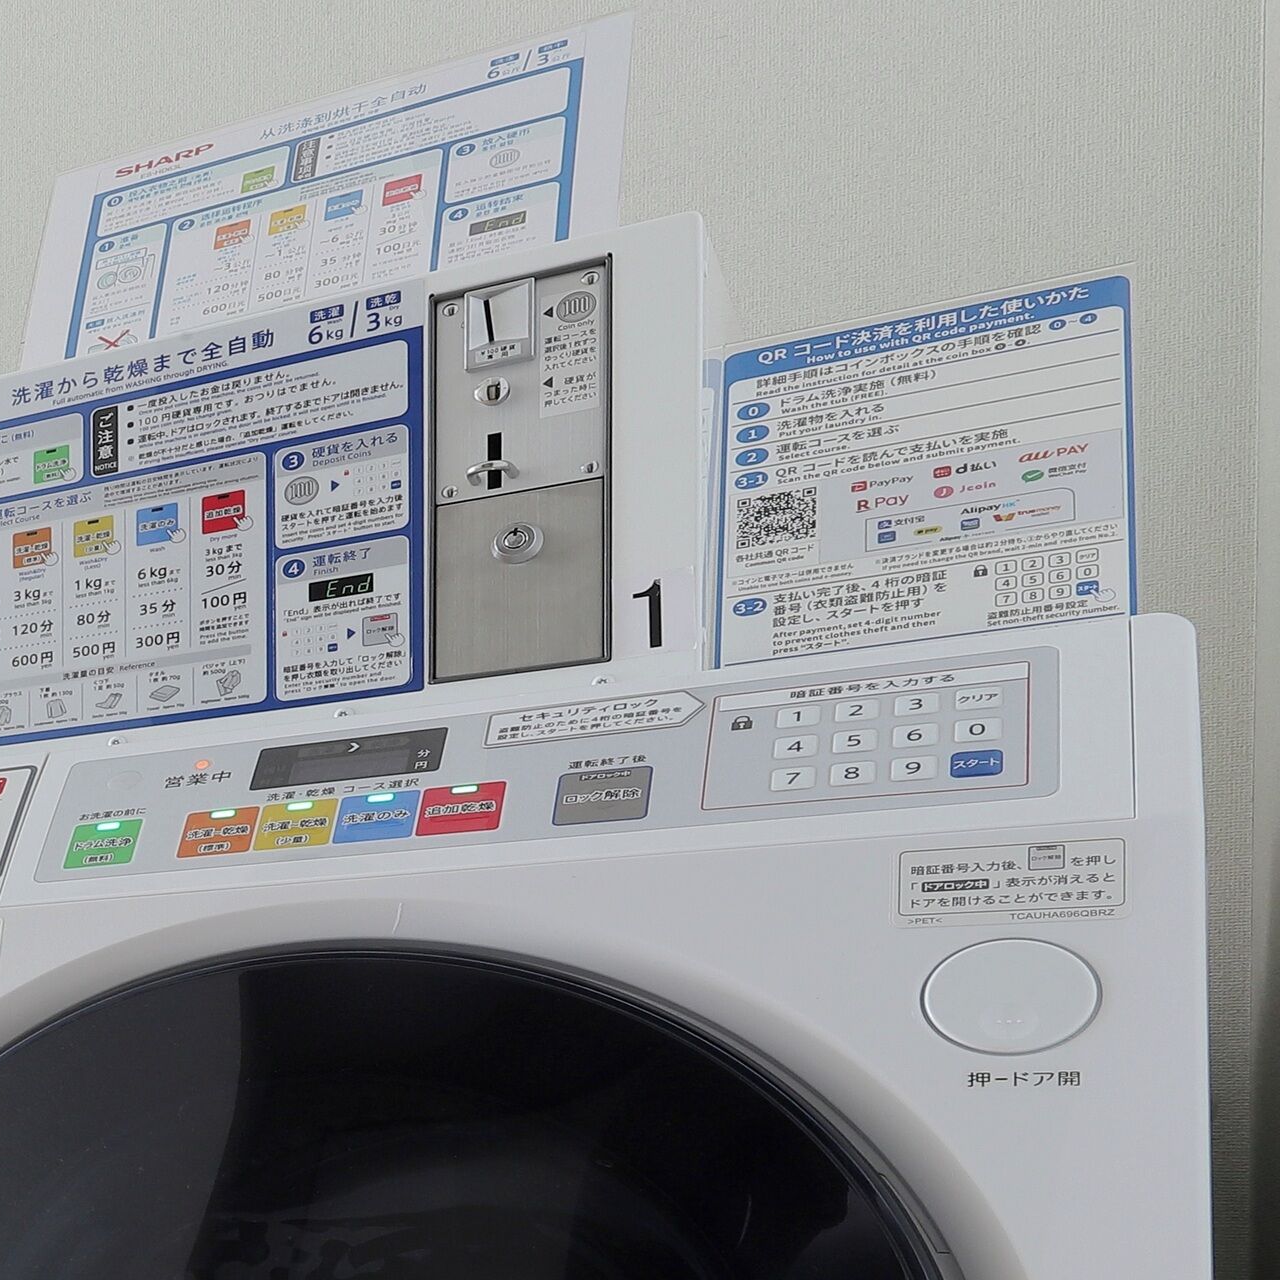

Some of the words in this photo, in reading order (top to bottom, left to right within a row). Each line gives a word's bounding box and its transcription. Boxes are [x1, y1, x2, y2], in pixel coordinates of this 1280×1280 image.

[115, 142, 214, 179] SHARP
[557, 321, 572, 332] Coin
[573, 318, 595, 330] only
[806, 353, 834, 364] How
[854, 344, 877, 356] use
[879, 337, 909, 352] with
[911, 333, 932, 347] QR
[934, 328, 967, 342] code
[969, 313, 1034, 335] payment.
[11, 328, 275, 407] 洗濯から乾燥まで全自動
[777, 402, 885, 432] 洗濯物を入れる
[96, 412, 114, 460] ご注意
[776, 425, 900, 455] 運転コースを選ぶ
[312, 433, 398, 459] 硬貨を入れる
[312, 455, 344, 467] Deposit
[345, 449, 372, 462] Coins
[94, 461, 117, 474] NOTICE
[869, 473, 914, 488] PayPay
[13, 514, 40, 524] Course
[312, 547, 371, 568] 運転終了
[313, 566, 339, 576] Finish
[326, 575, 372, 597] End
[633, 578, 662, 648] 1
[772, 598, 923, 628] 設定し、スタートを押す
[1044, 608, 1079, 622] security
[1080, 603, 1120, 617] number.
[119, 661, 155, 672] Reference
[789, 673, 956, 700] 暗証番号を入力する
[909, 697, 923, 710] 3
[957, 692, 1000, 705] クリア
[519, 697, 659, 723] セキュリティロック
[848, 704, 864, 717] 2
[907, 727, 922, 743] 6
[968, 722, 985, 736] 0
[786, 740, 804, 754] 4
[847, 734, 861, 747] 5
[568, 753, 647, 770] 運転終了後
[905, 761, 922, 776] 9
[952, 755, 1001, 771] スタート
[164, 770, 233, 790] 営業中
[785, 772, 801, 785] 7
[843, 766, 861, 780] 8
[343, 808, 410, 824] 洗濯のみ
[425, 801, 496, 817] 追加乾燥
[1070, 854, 1116, 866] を押し
[911, 890, 1113, 908] ドアを開けることができます。
